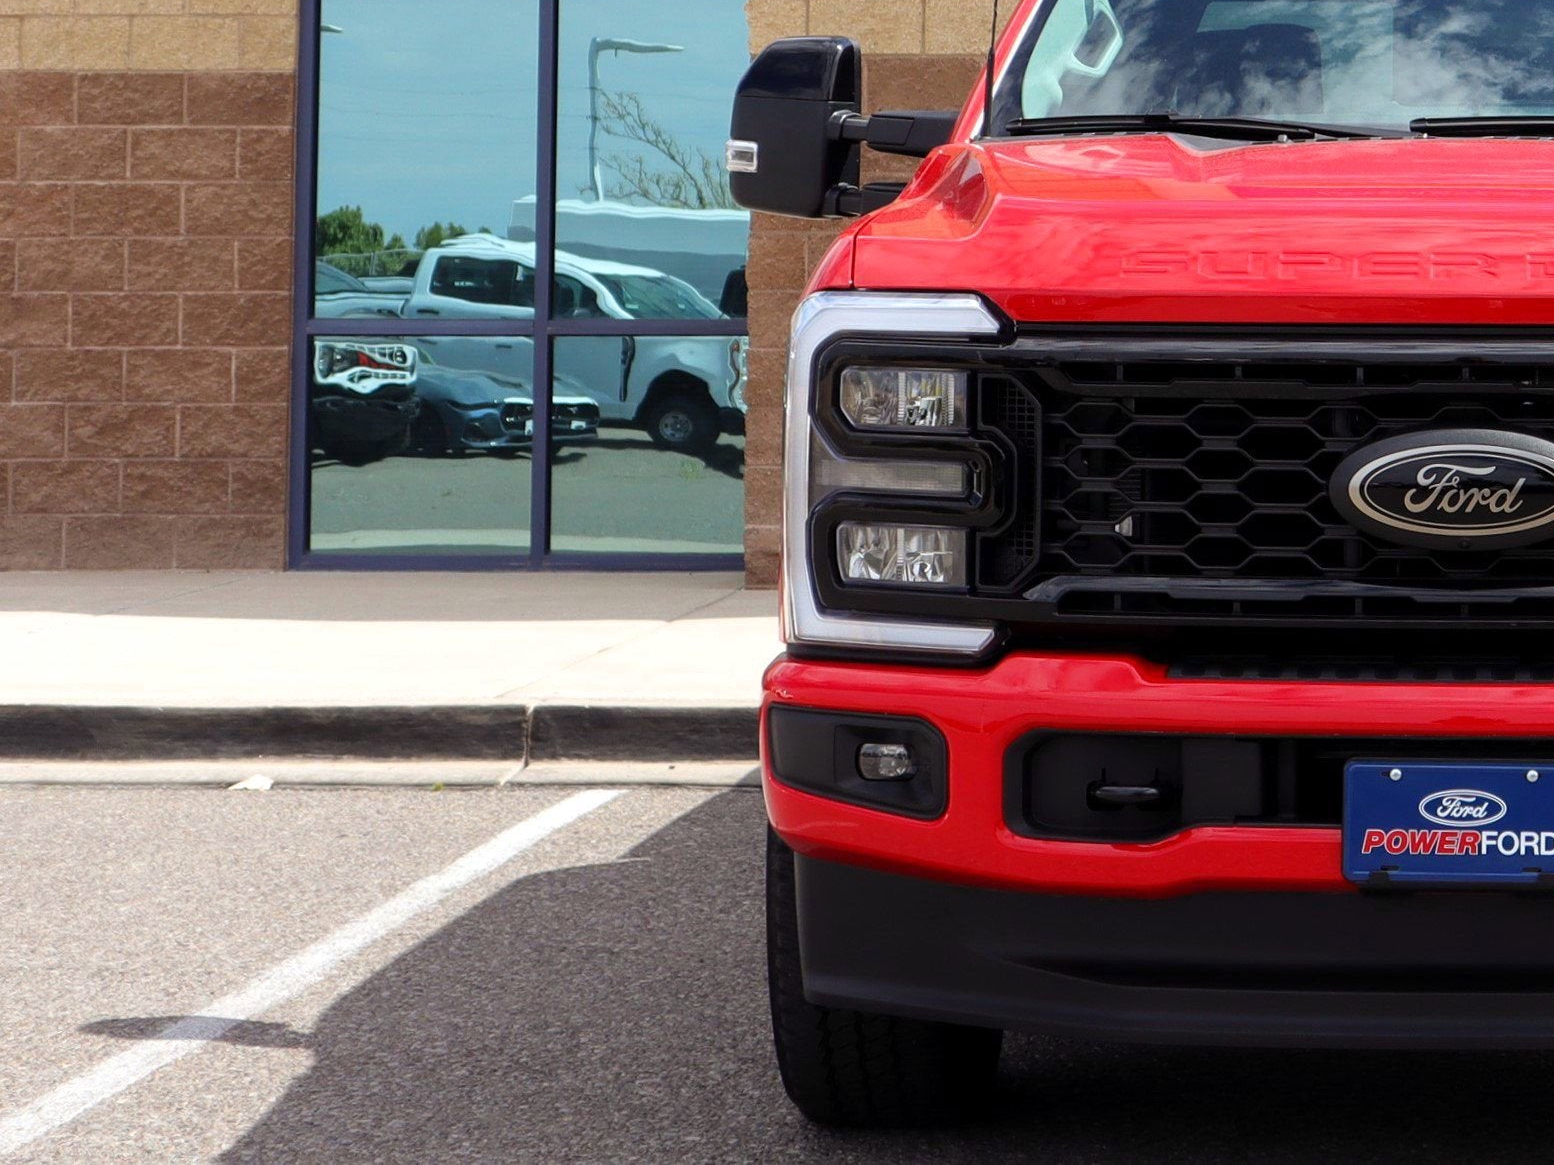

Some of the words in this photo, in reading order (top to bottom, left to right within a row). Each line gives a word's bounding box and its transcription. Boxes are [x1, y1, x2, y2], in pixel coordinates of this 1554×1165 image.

[1120, 250, 1498, 279] SUPER
[1403, 463, 1526, 513] Ford
[1436, 795, 1489, 819] Ford
